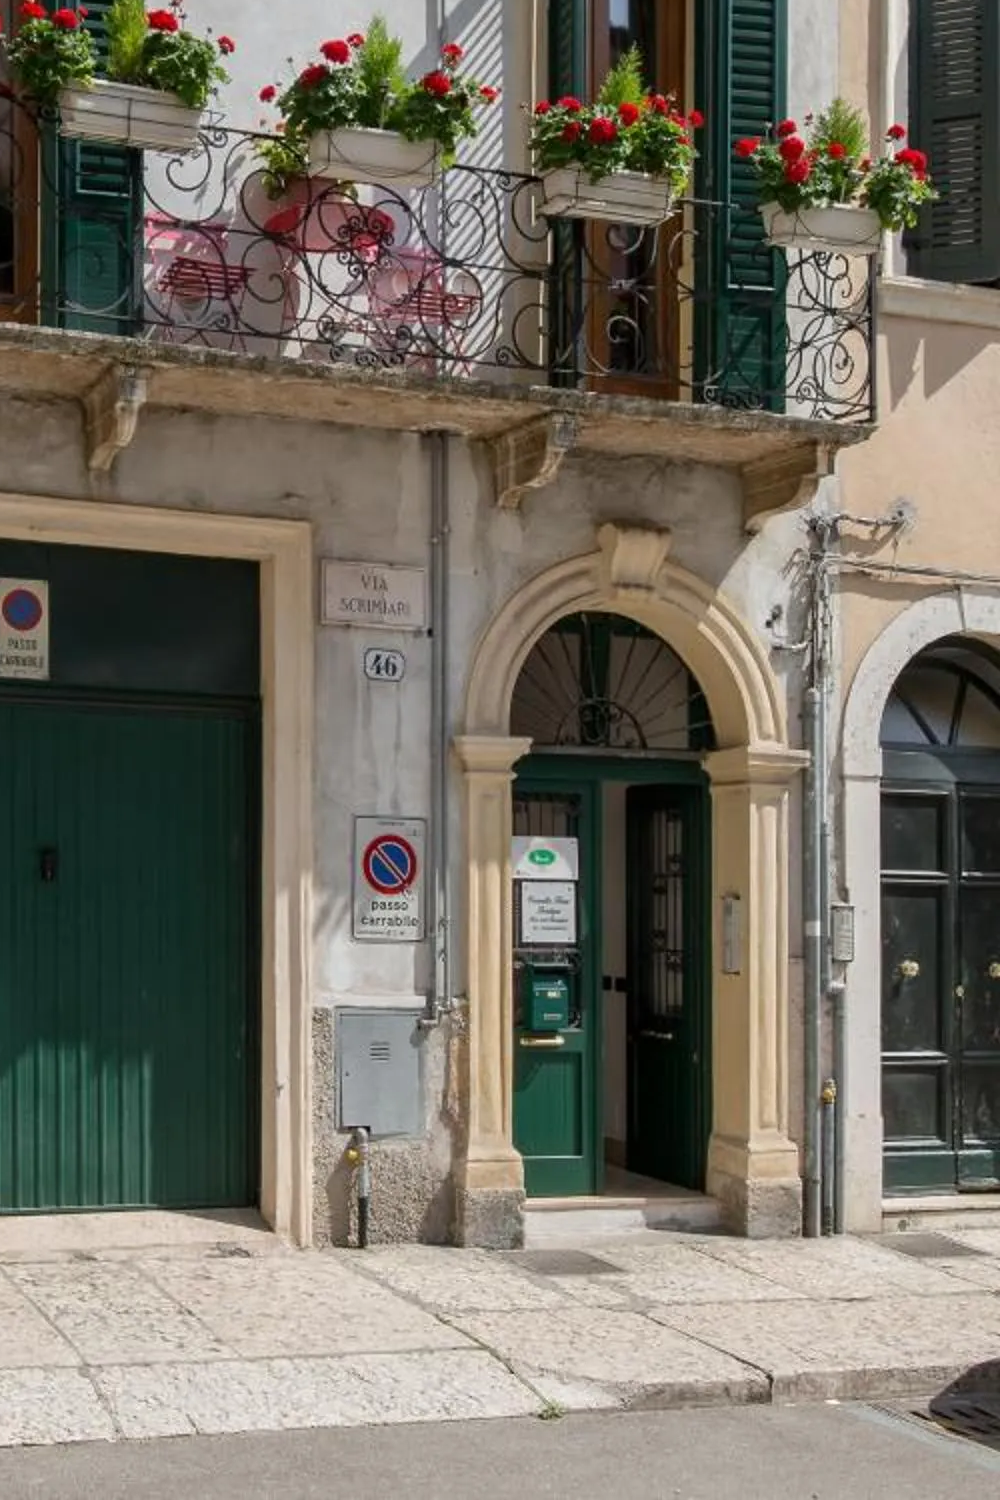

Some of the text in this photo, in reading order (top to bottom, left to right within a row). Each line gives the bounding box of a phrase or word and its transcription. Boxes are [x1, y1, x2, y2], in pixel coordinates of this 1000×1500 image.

[361, 574, 388, 591] VIA
[370, 654, 397, 676] 46
[371, 901, 408, 911] passo
[361, 916, 419, 926] carrabile
